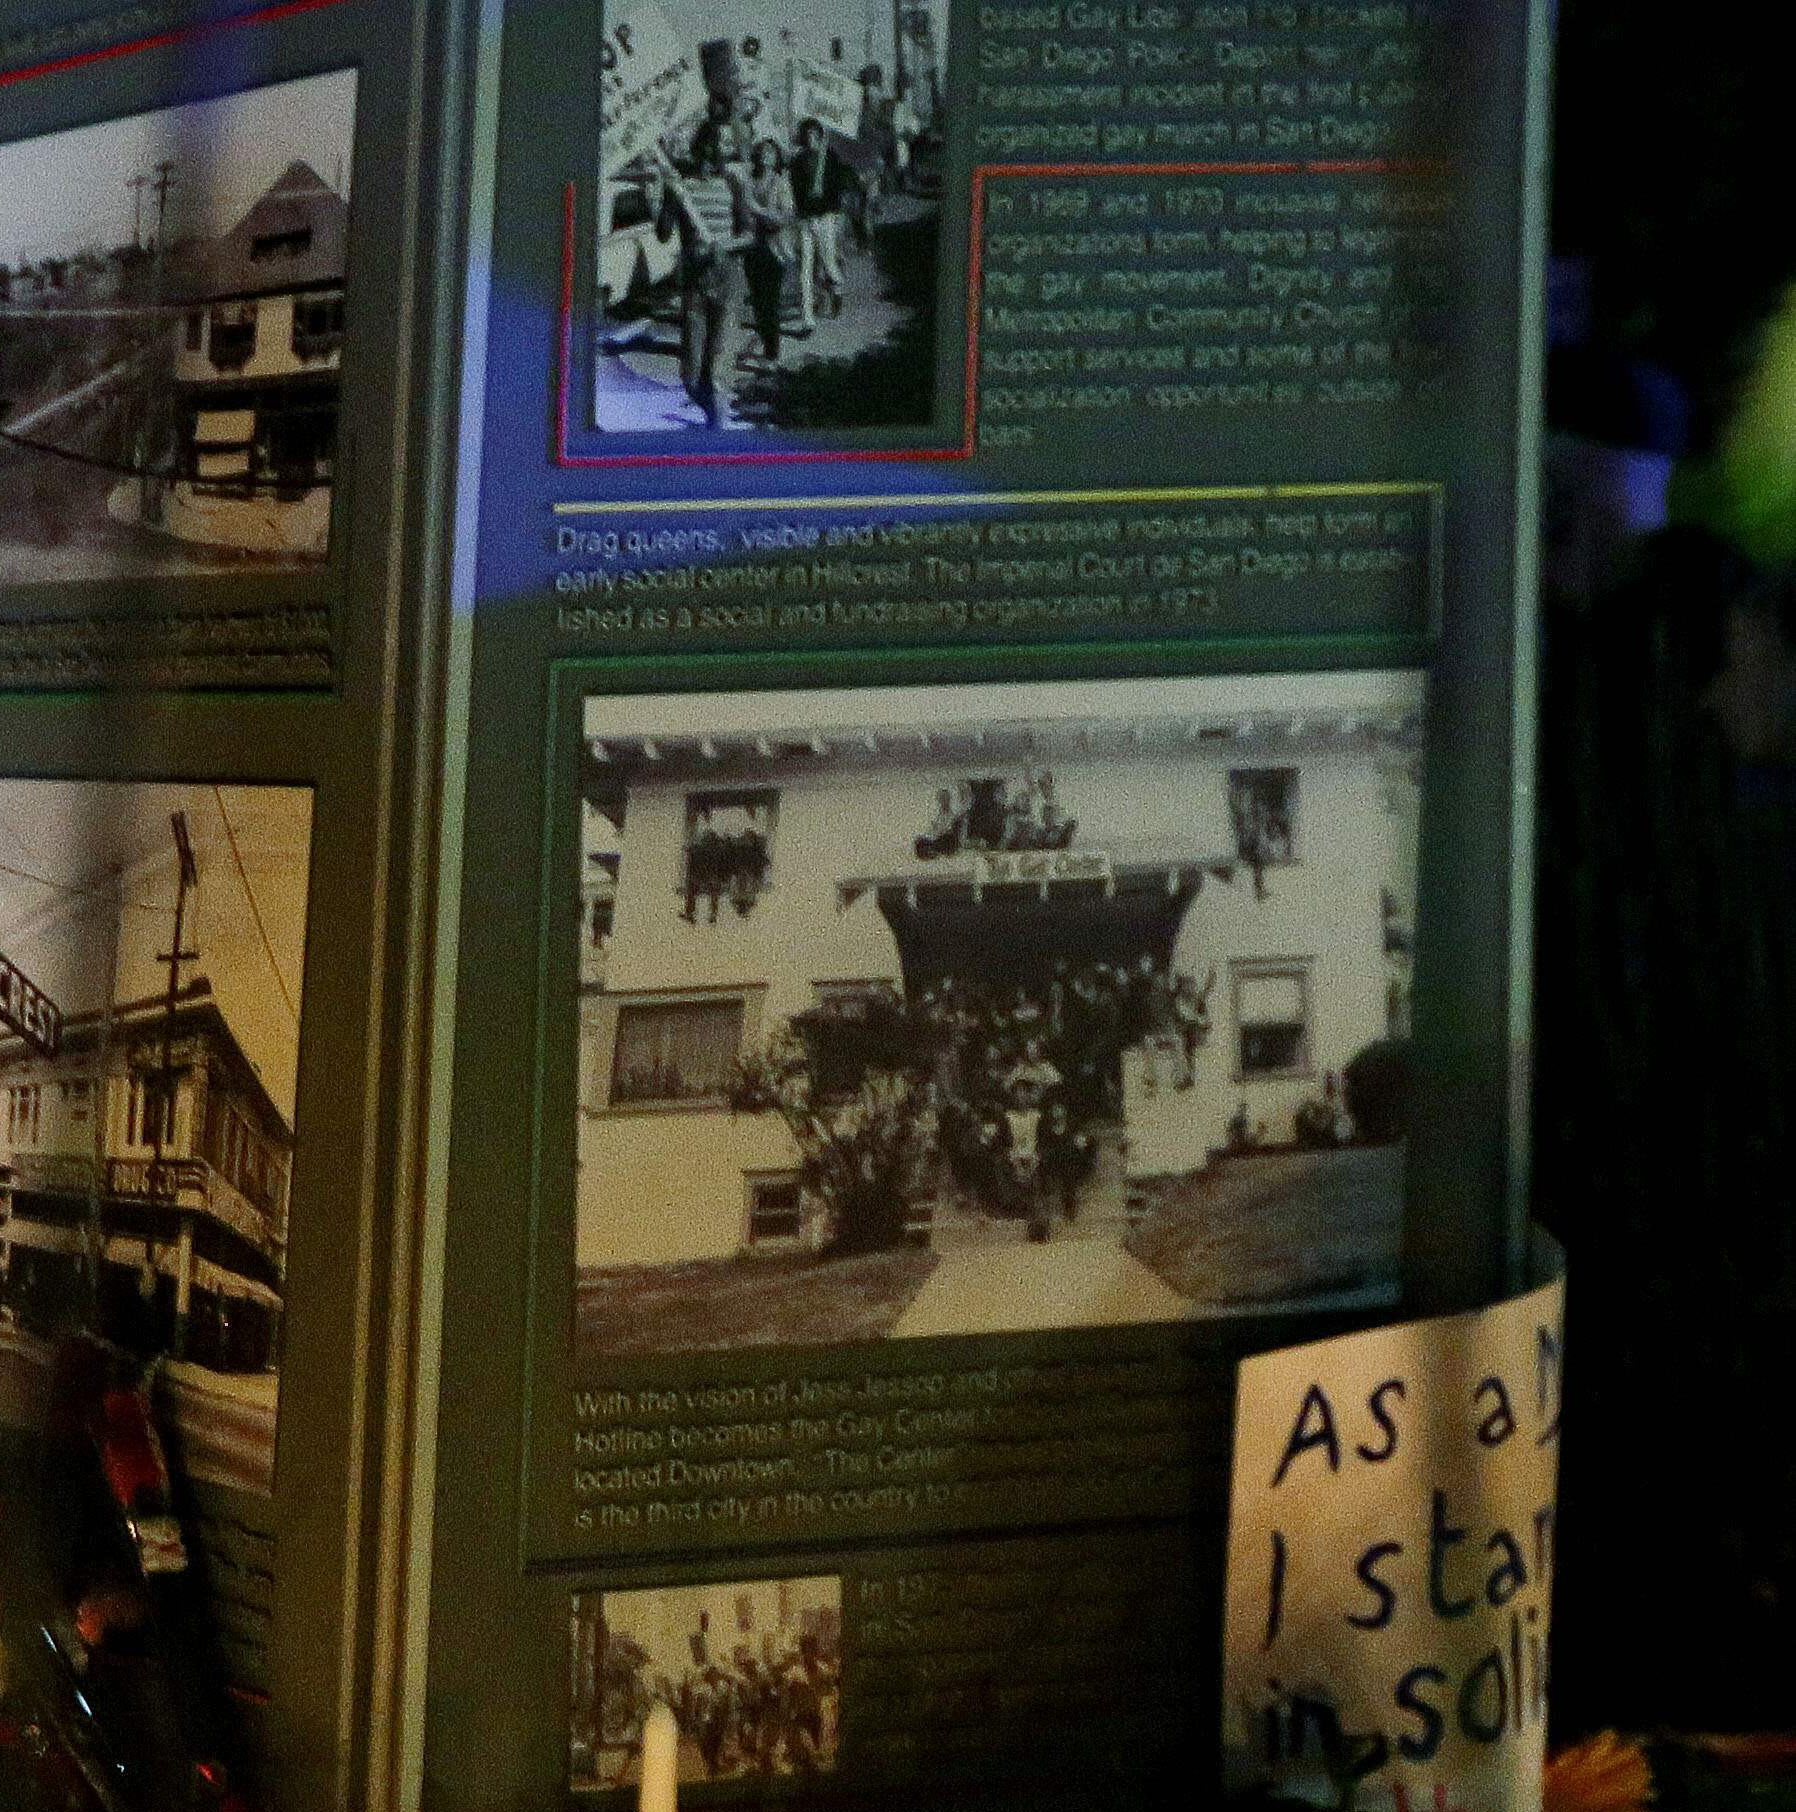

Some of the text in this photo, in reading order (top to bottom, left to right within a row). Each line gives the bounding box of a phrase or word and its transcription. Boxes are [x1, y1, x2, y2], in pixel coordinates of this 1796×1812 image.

[559, 524, 620, 561] Drag
[741, 521, 821, 551] visible
[826, 520, 873, 549] and
[556, 565, 618, 598] early
[621, 562, 696, 592] social
[700, 562, 780, 591] center
[924, 555, 970, 584] The
[558, 603, 634, 632] lished
[638, 605, 671, 631] as
[700, 602, 773, 630] social
[778, 601, 826, 628] and
[572, 1391, 632, 1418] With
[638, 1390, 679, 1414] the
[684, 1386, 757, 1411] vision
[762, 1379, 789, 1406] of
[573, 1427, 664, 1454] Hotline
[669, 1420, 785, 1450] becomes
[789, 1416, 831, 1440] the
[835, 1409, 886, 1441] Gay
[572, 1462, 663, 1494] located
[600, 1503, 641, 1528] the
[645, 1500, 701, 1526] third
[784, 1490, 825, 1516] the
[829, 1484, 918, 1512] country
